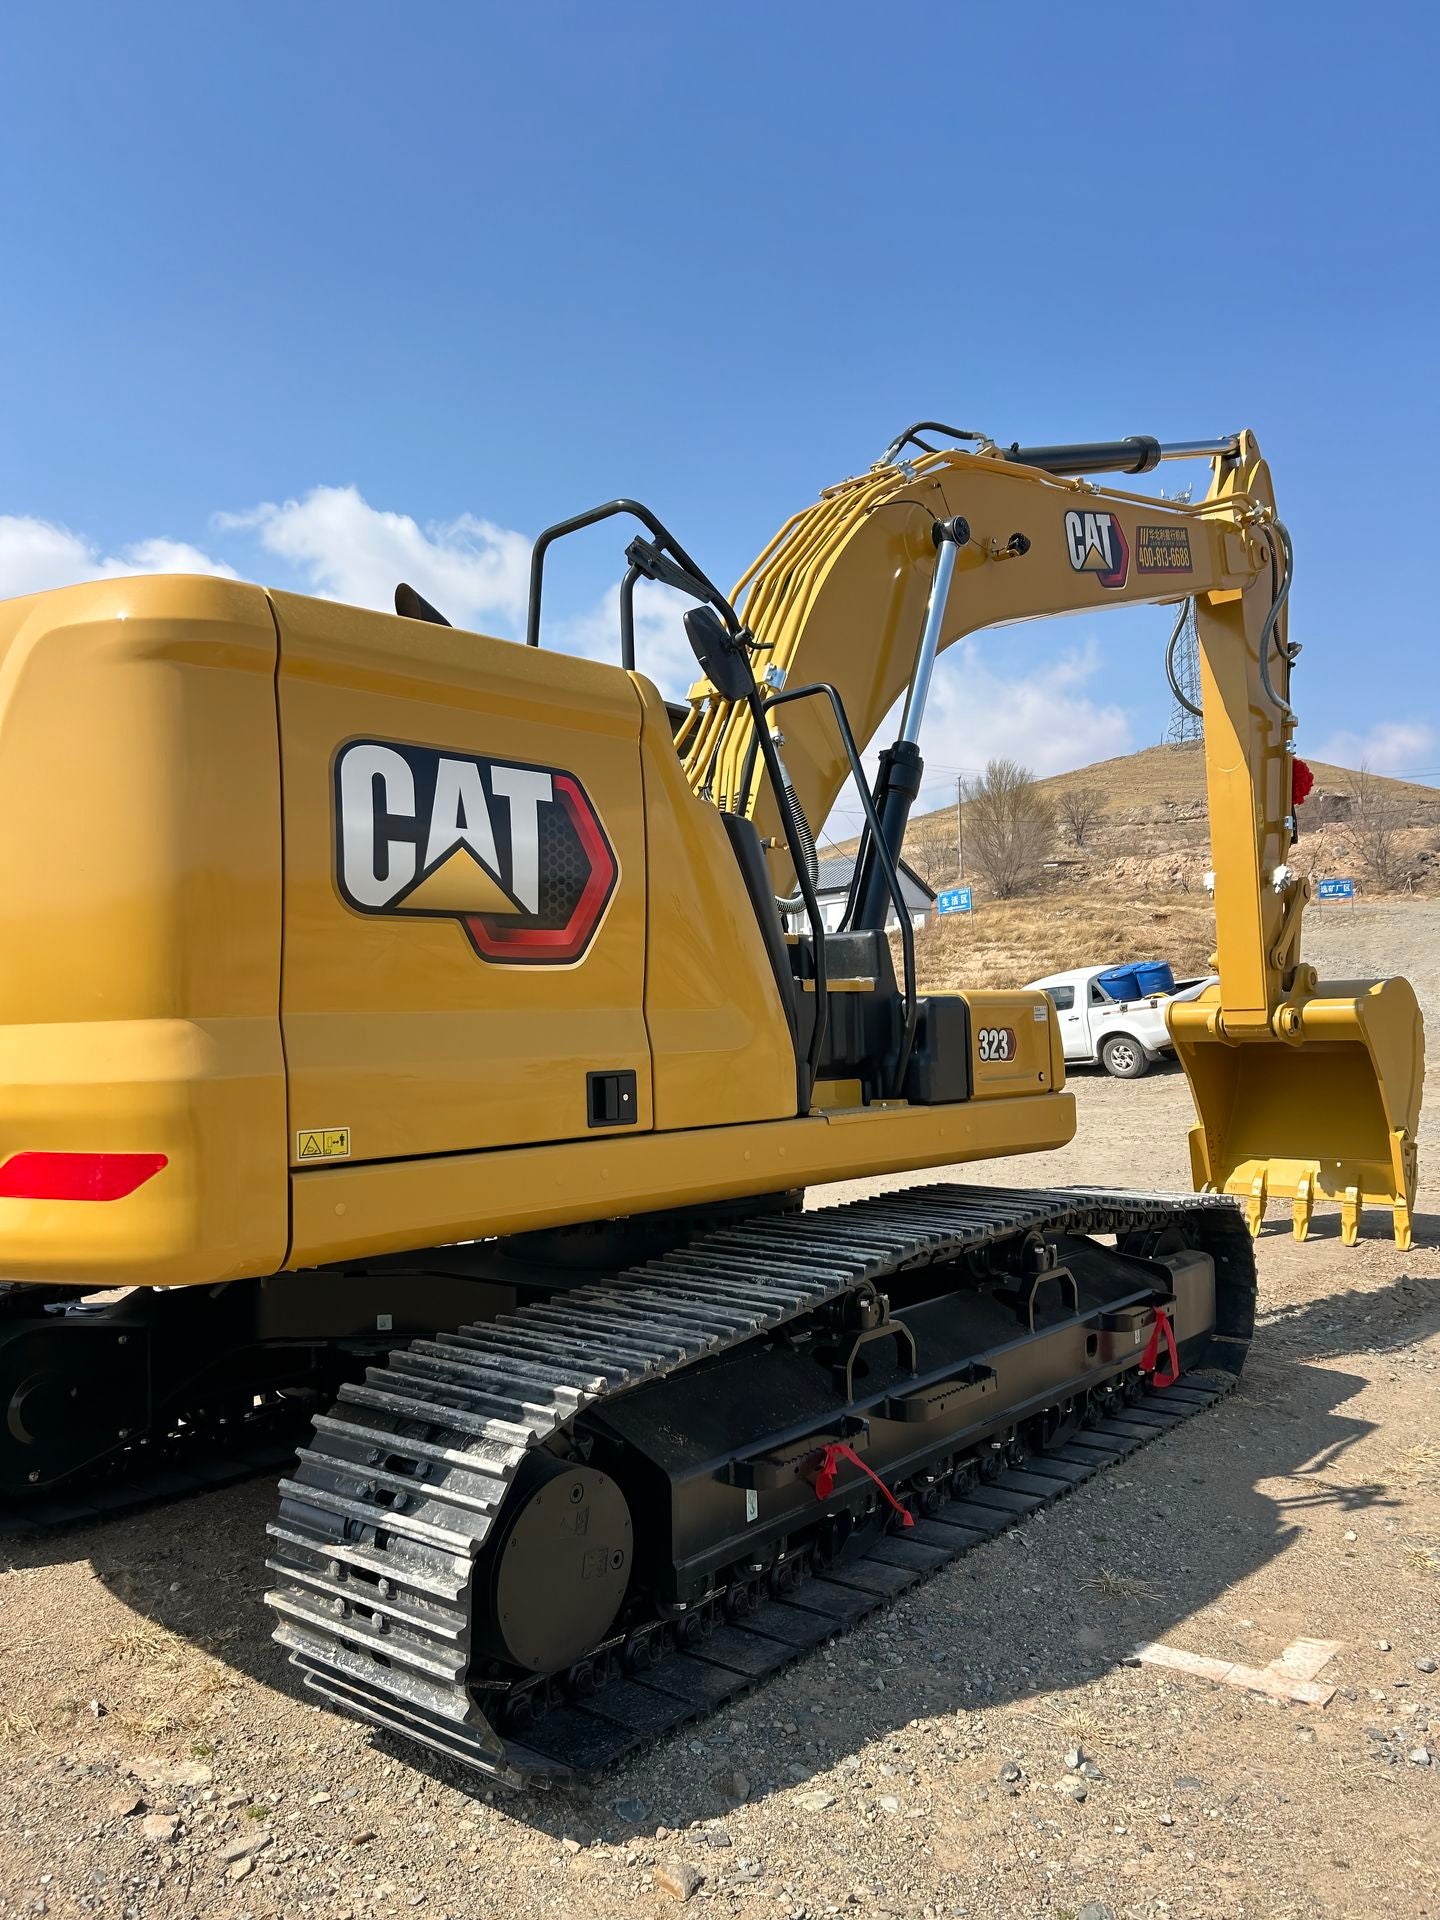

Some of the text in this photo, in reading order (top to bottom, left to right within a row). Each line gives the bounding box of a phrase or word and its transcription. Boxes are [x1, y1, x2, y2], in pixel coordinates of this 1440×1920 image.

[1065, 511, 1113, 569] CAT
[1139, 547, 1190, 567] 400-813-6688
[340, 744, 553, 915] CAT
[941, 894, 968, 907] 生活区
[979, 1029, 1008, 1060] 323
